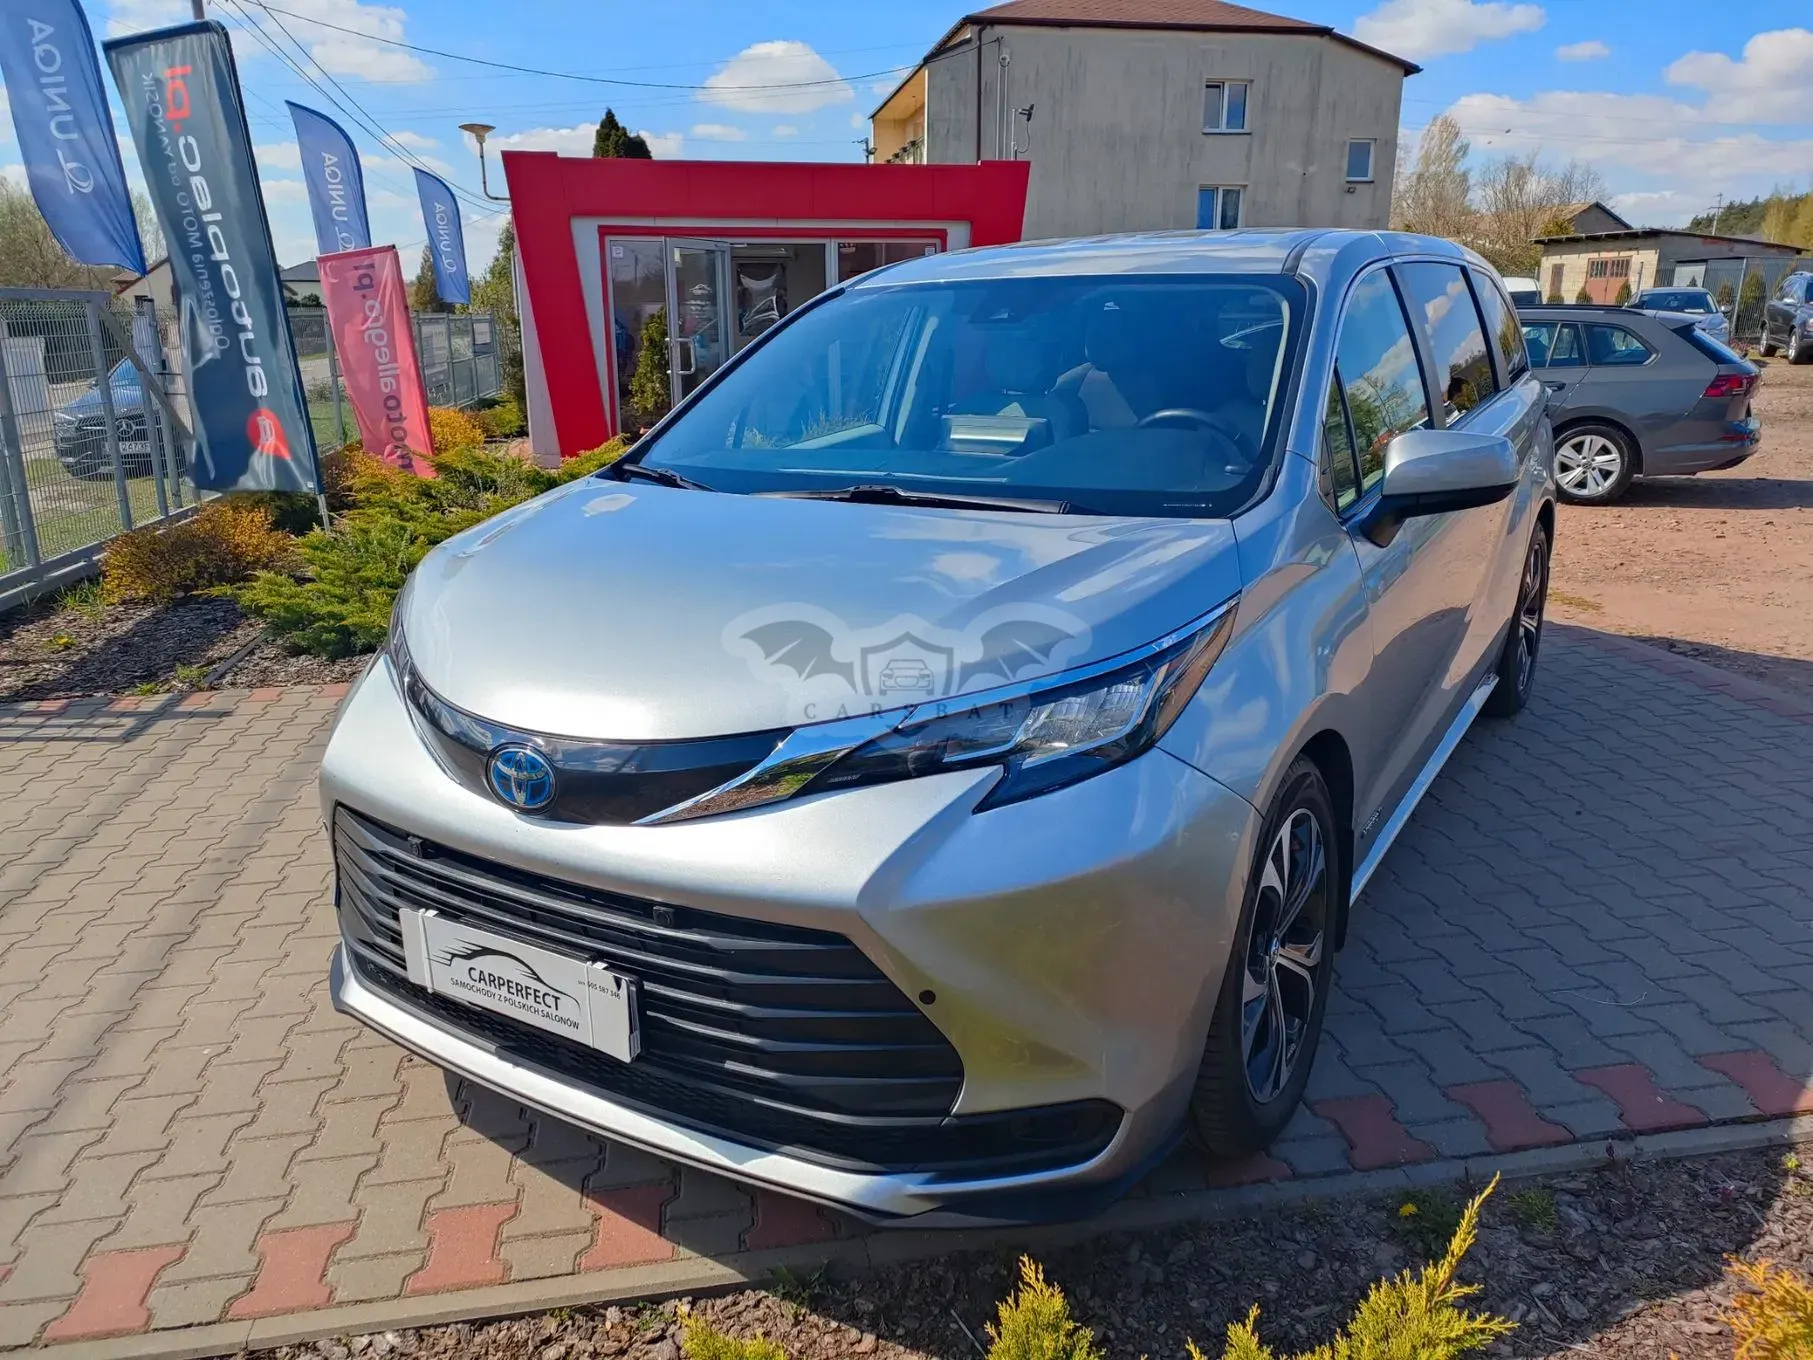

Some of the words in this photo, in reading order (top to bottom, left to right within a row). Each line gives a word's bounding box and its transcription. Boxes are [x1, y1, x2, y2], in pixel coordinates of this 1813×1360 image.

[450, 977, 496, 999] SAMOCHODY
[497, 993, 503, 1002] Z
[503, 996, 540, 1015] POLSKICH
[540, 1010, 580, 1030] SALONÓW
[468, 966, 561, 1011] CARPERFECT
